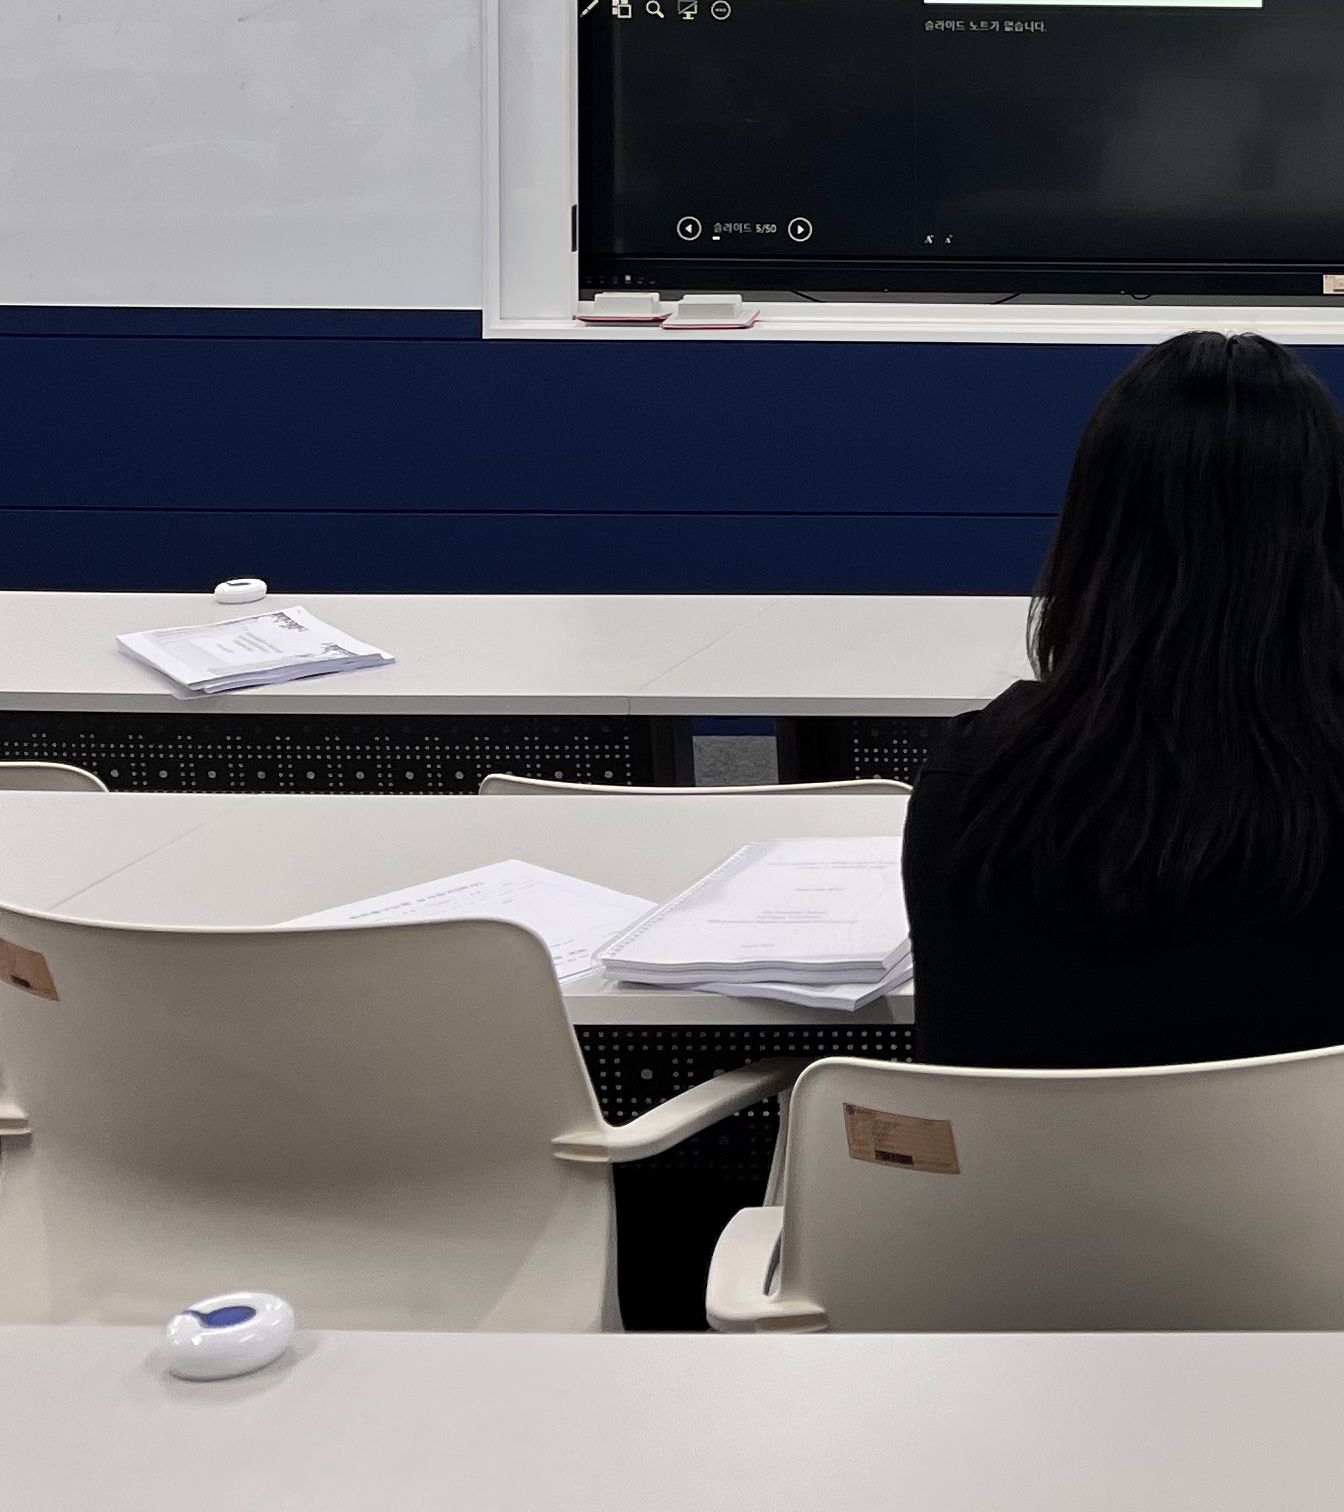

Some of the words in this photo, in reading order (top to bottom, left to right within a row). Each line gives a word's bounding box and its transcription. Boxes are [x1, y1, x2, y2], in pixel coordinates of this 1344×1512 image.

[925, 20, 965, 31] 슬라이드
[970, 21, 1000, 32] 노트가
[1004, 21, 1047, 32] 없습니다.
[714, 222, 752, 233] 슬라이드
[756, 224, 777, 233] 5/50
